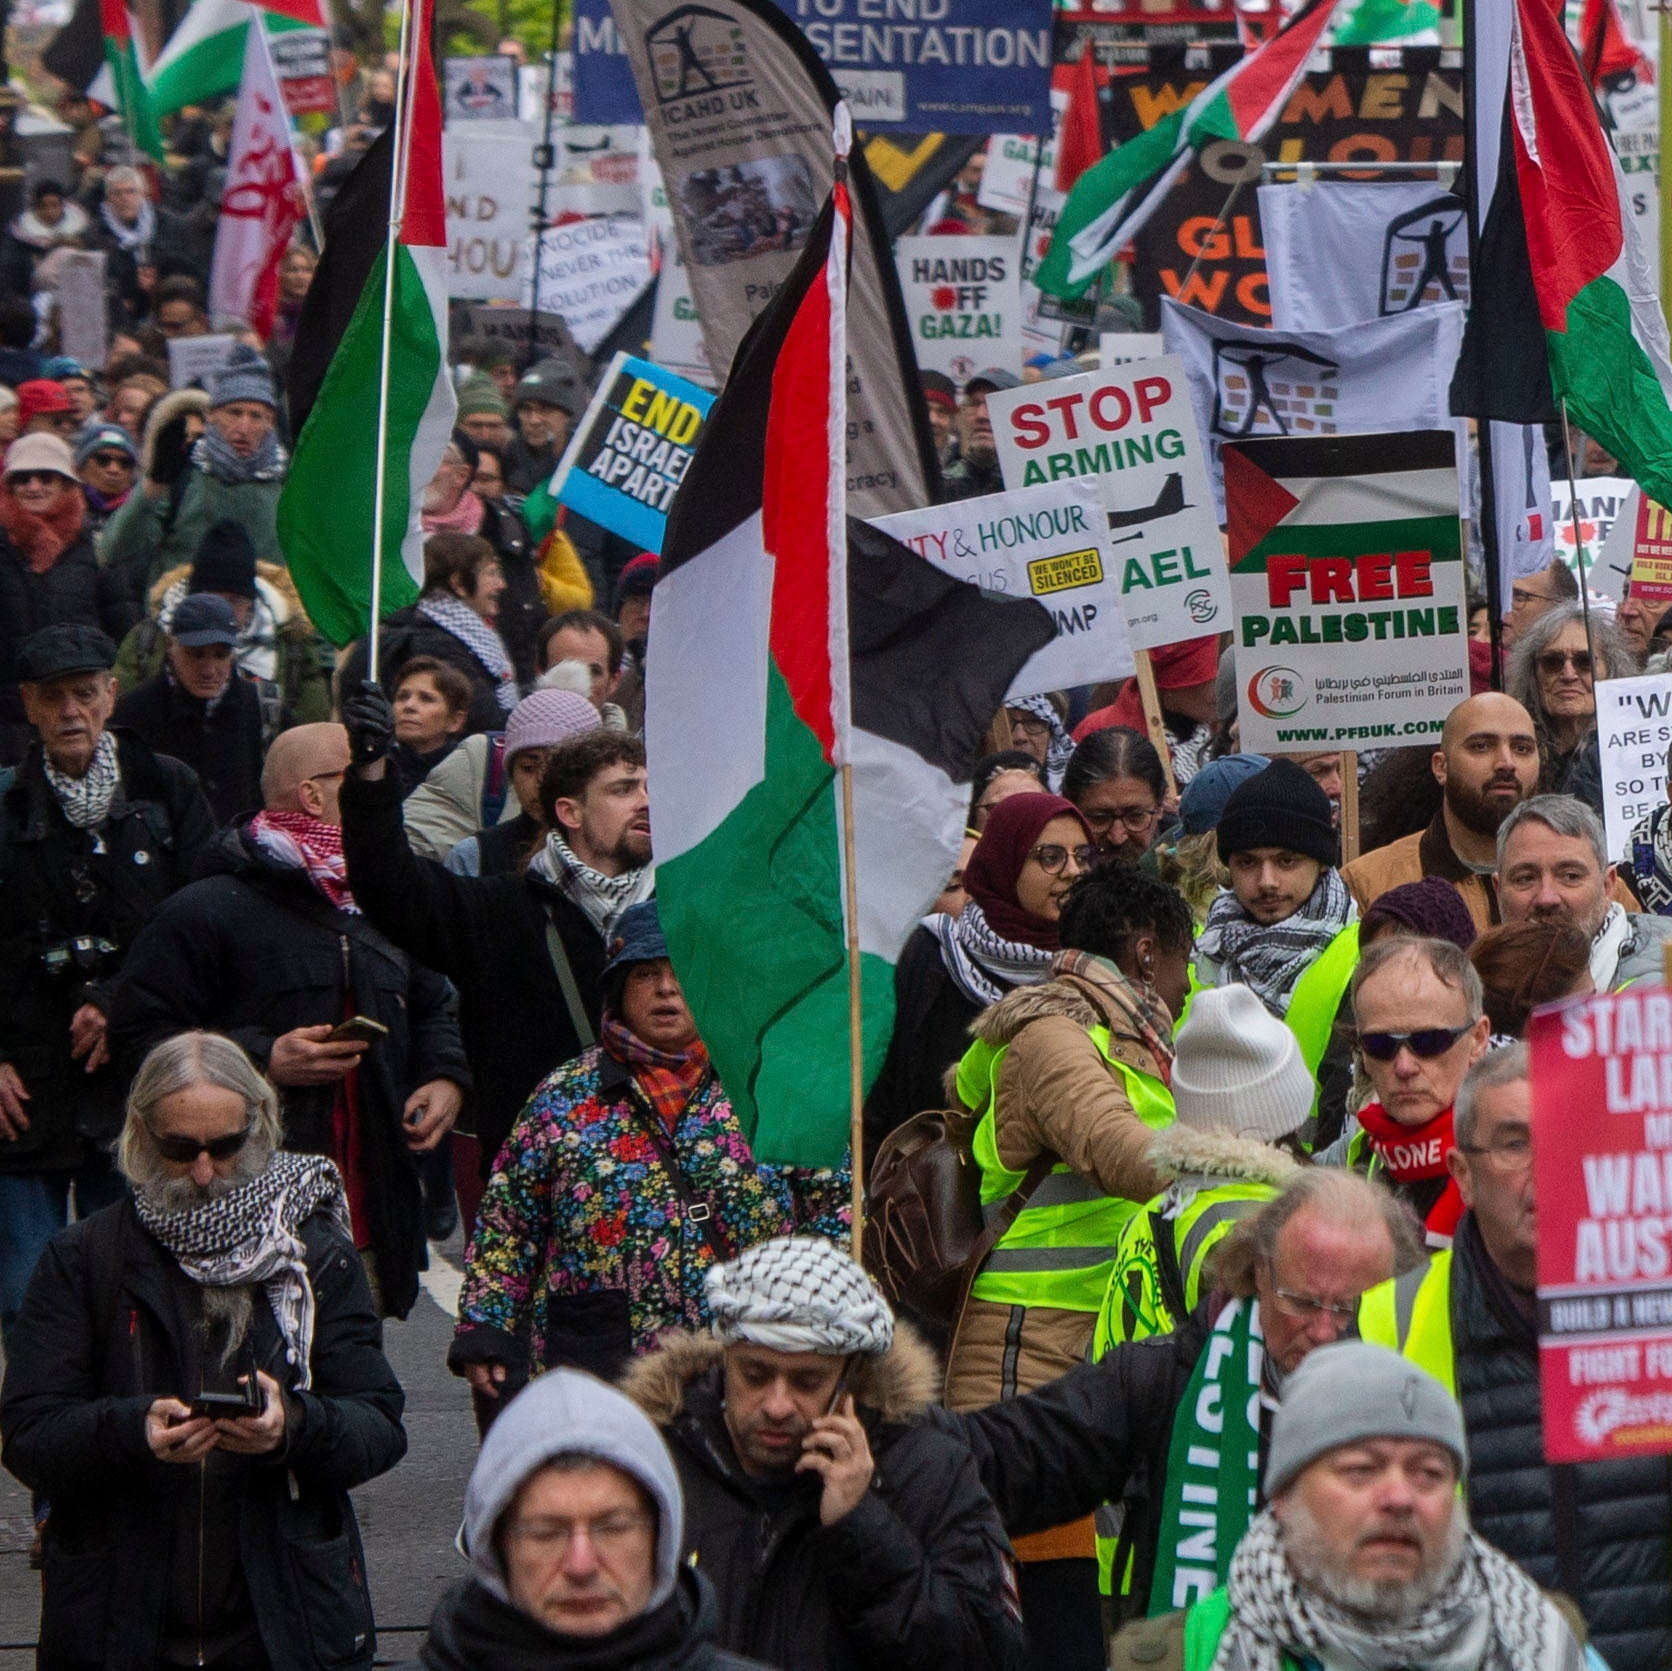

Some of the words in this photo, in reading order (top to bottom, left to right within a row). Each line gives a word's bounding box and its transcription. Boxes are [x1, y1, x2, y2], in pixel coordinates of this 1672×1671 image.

[911, 256, 1006, 284] HANDS
[919, 312, 1003, 341] GAZA!
[620, 377, 702, 445] END
[1010, 376, 1174, 451] STOP
[1020, 428, 1187, 489] ARMING
[587, 449, 682, 514] APART
[977, 504, 1089, 554] HONOUR
[1034, 561, 1051, 576] WE
[1051, 555, 1082, 573] WON'T
[1083, 552, 1096, 567] BE
[1035, 564, 1099, 590] SILENCED
[1266, 549, 1434, 609] FREE
[1241, 605, 1460, 647] PALESTINE
[1315, 691, 1376, 705] Palestinian
[1377, 689, 1412, 701] Forum
[1414, 687, 1425, 698] in
[1427, 684, 1464, 697] Britain
[1276, 719, 1447, 743] WWW.PFBUK.COM
[1607, 731, 1651, 749] ARE
[1641, 751, 1668, 769] BY
[1614, 779, 1644, 797] SO
[1621, 804, 1649, 821] BE
[1549, 1298, 1610, 1332] BUILD
[1612, 1298, 1631, 1327] A
[1568, 1345, 1642, 1385] FIGHT
